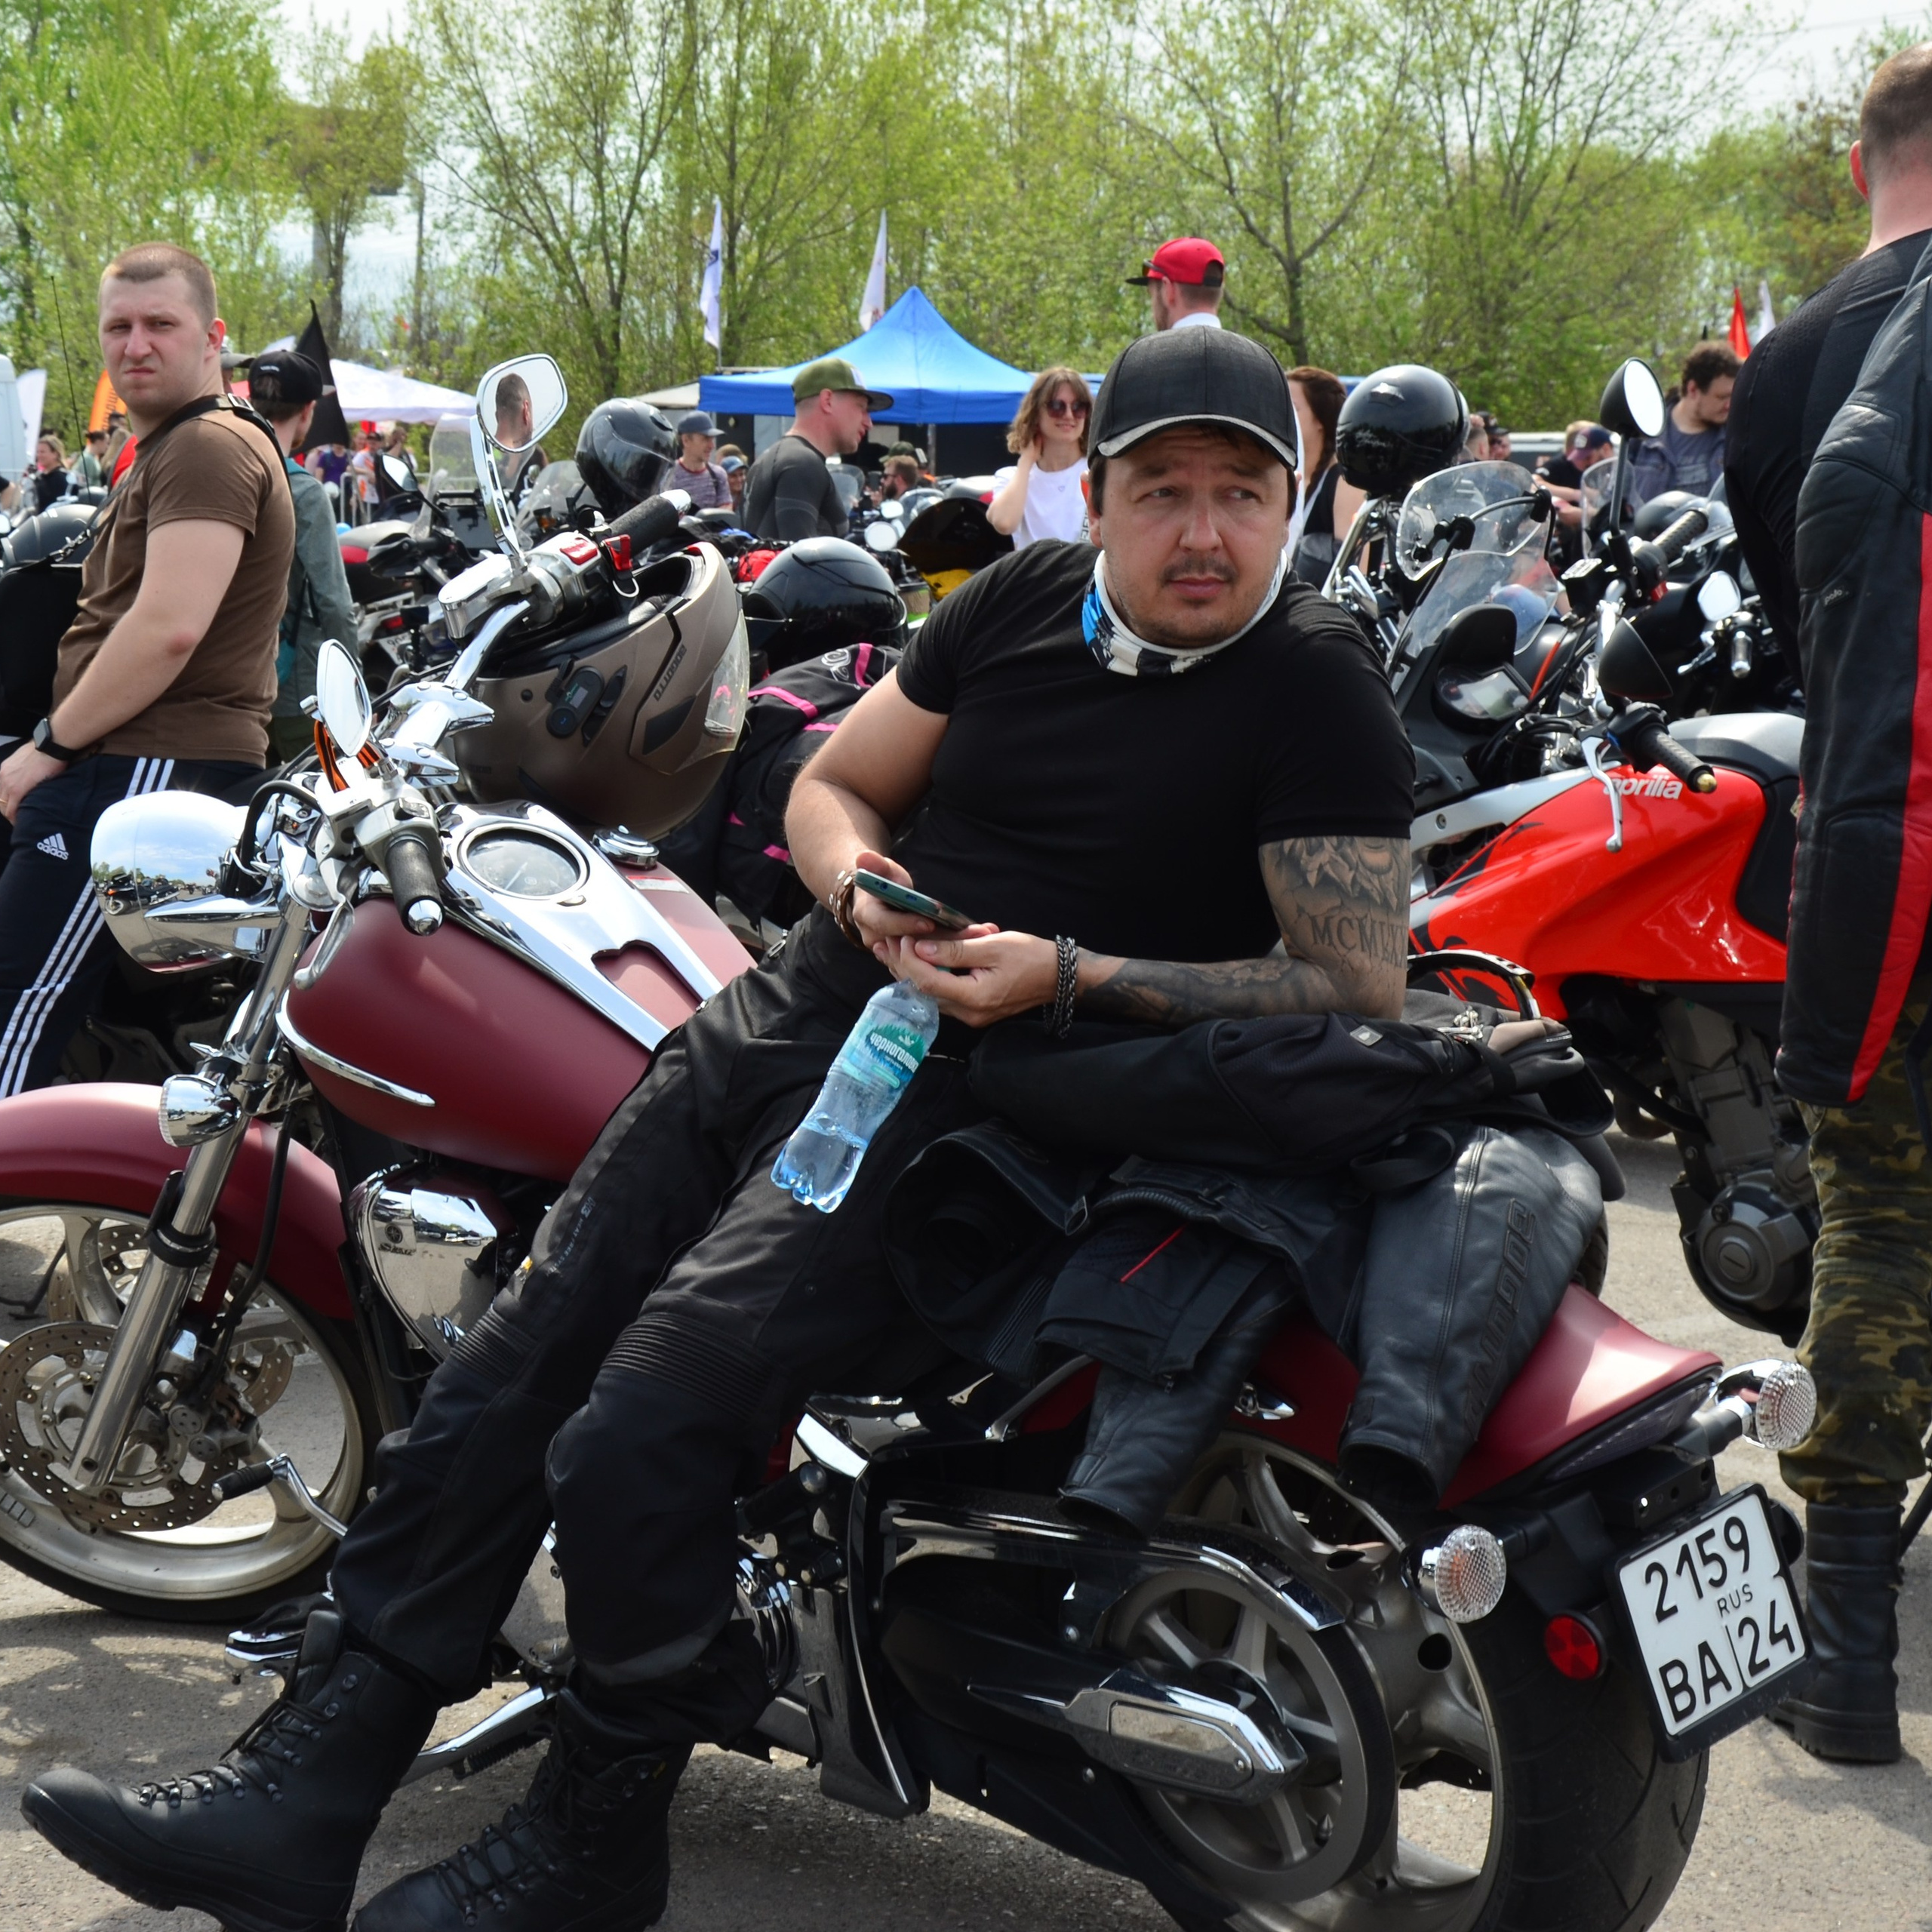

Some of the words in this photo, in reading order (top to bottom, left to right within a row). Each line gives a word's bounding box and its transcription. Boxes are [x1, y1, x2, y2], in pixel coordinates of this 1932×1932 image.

[1824, 589, 1843, 606] polo
[36, 841, 69, 860] adidas
[1644, 1516, 1750, 1623] 2159
[1717, 1583, 1753, 1617] RUS
[1659, 1641, 1732, 1723] BA
[1738, 1600, 1795, 1677] 24
